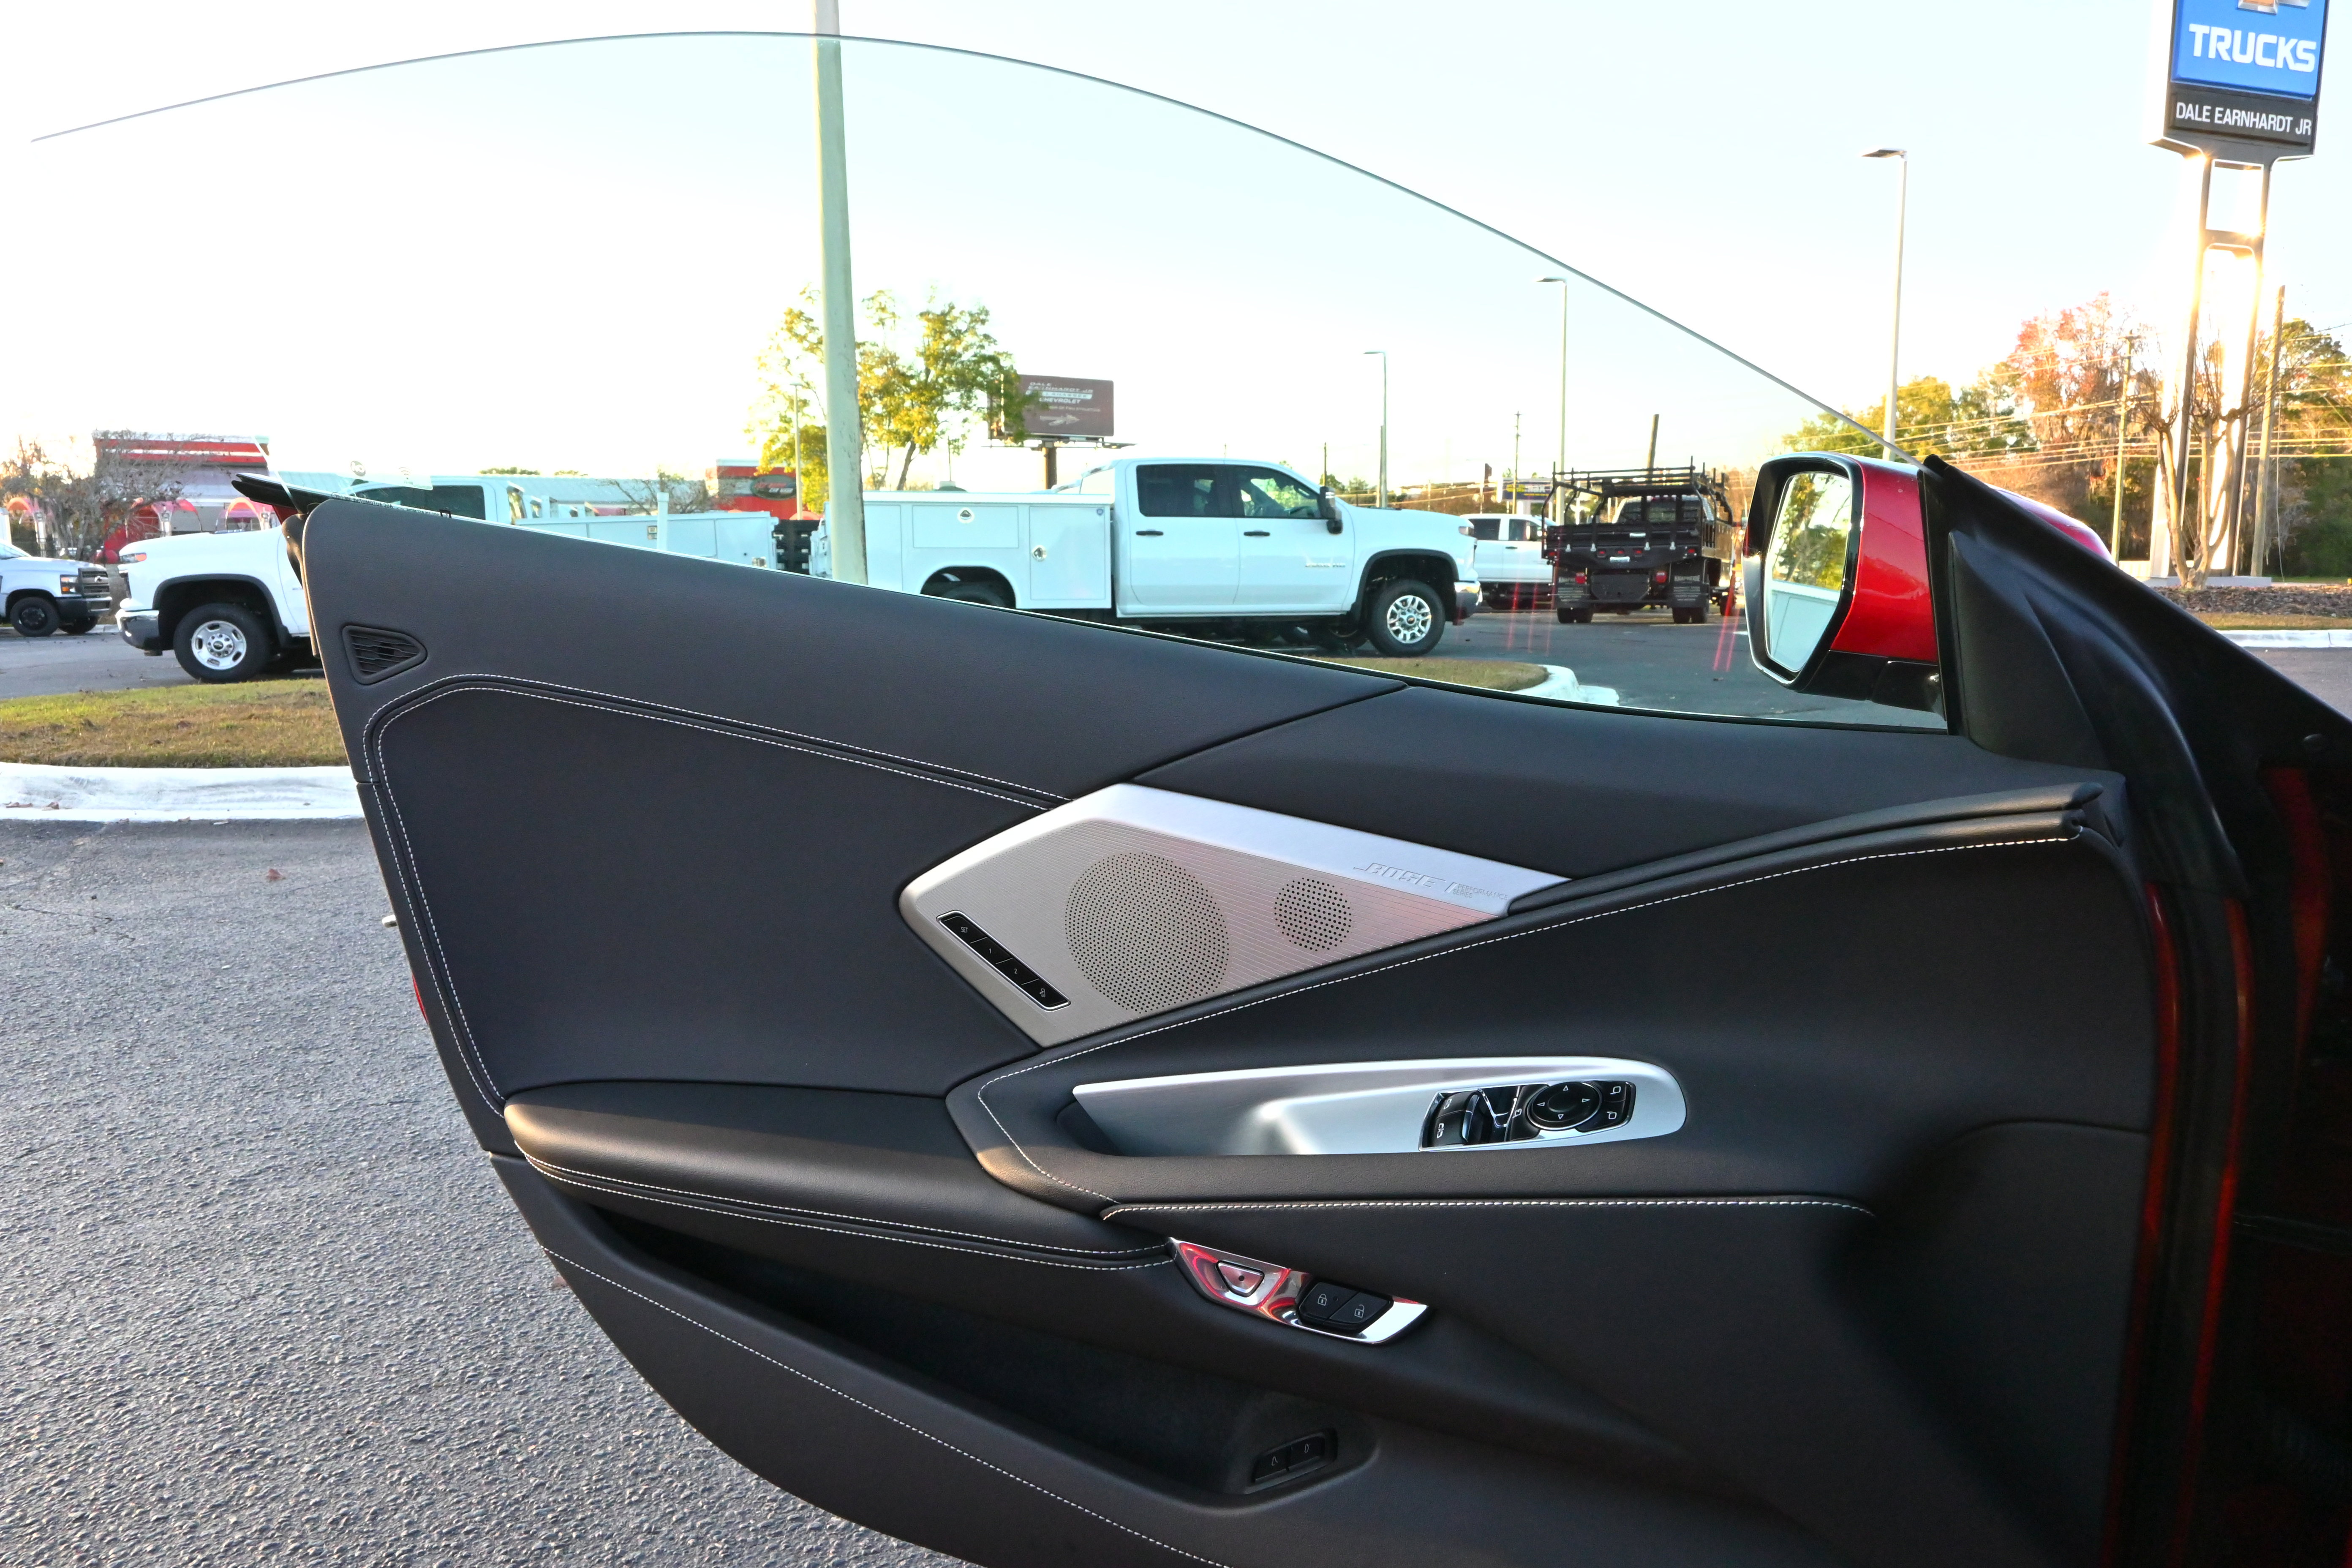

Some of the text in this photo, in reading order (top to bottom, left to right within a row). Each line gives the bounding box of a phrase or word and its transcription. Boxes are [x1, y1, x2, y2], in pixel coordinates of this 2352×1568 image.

[2189, 23, 2317, 73] TRUCKS
[2176, 102, 2312, 136] DALE EARNHARDT JR
[1362, 862, 1441, 888] BOSE
[1452, 888, 1474, 899] SERIES
[1456, 883, 1508, 901] PERFORMANCE
